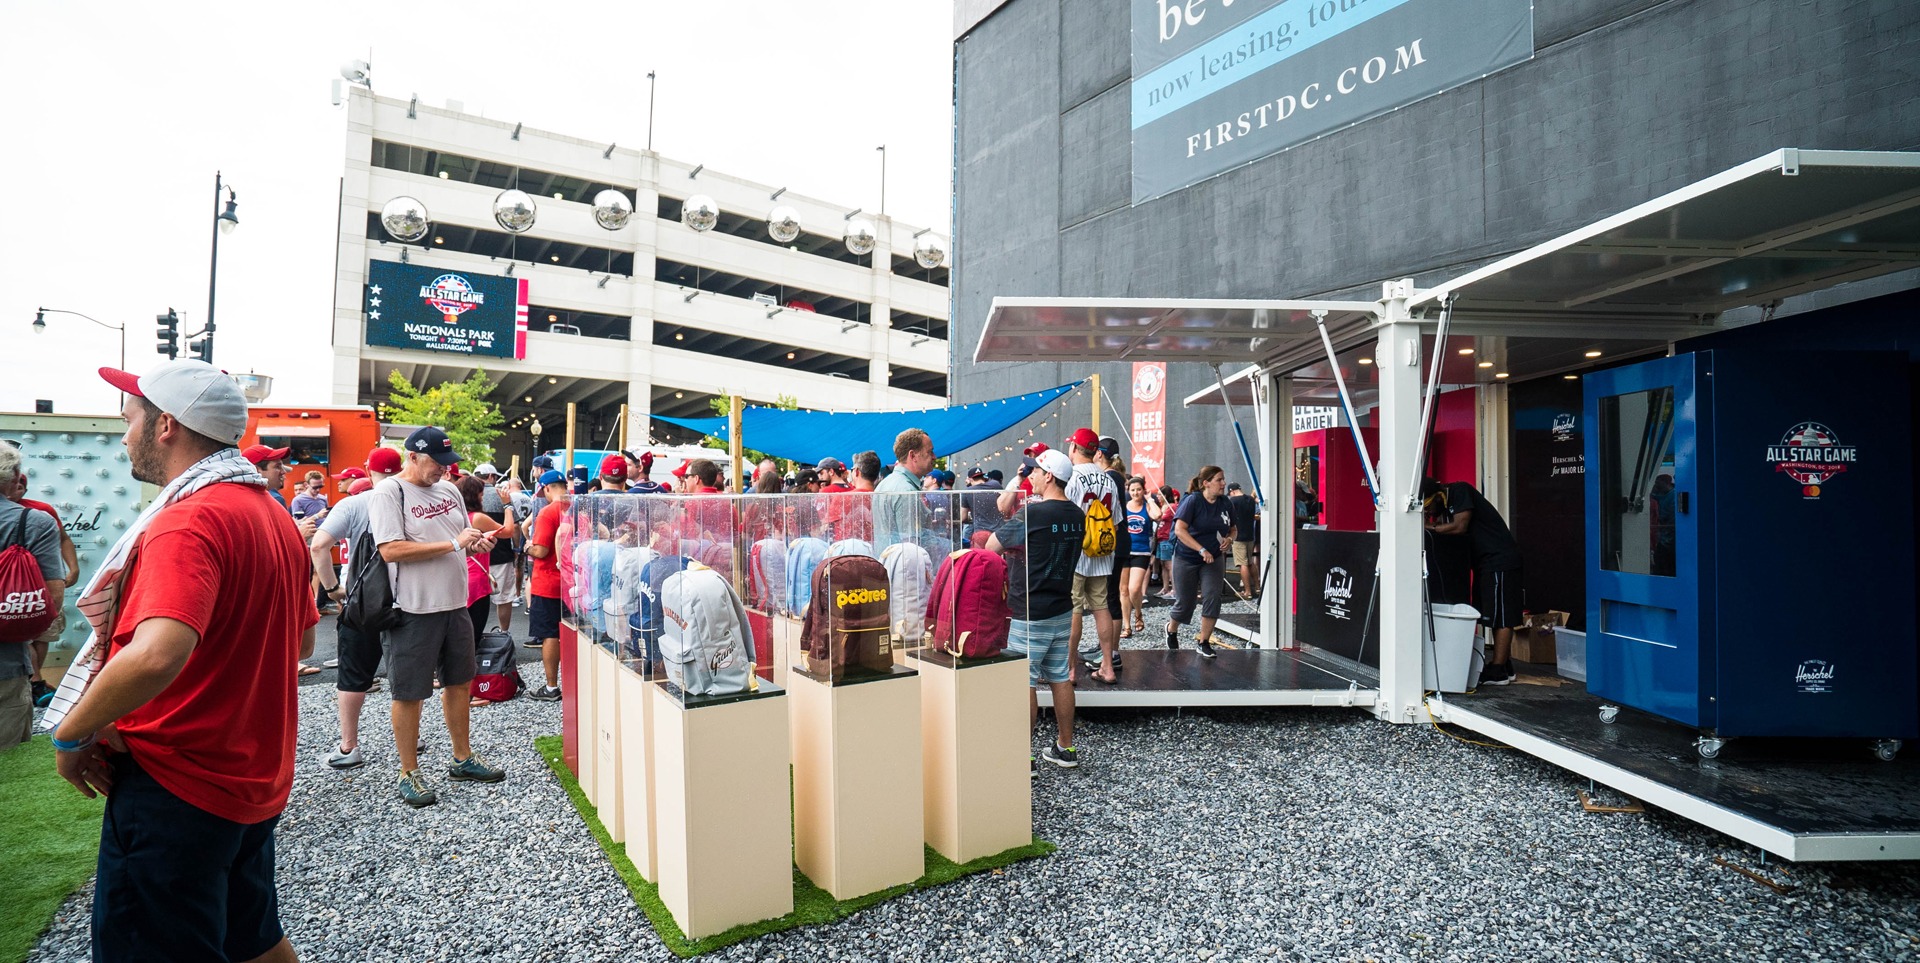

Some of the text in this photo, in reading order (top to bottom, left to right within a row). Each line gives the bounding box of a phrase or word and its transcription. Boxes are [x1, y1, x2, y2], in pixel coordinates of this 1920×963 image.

[1156, 0, 1207, 44] be
[1148, 0, 1368, 107] now leasing. tou
[419, 287, 436, 299] ALL
[437, 289, 460, 301] STAR
[460, 292, 484, 304] GAME
[404, 323, 495, 341] NATIONALS PARK
[409, 333, 438, 342] TONIGHT
[447, 337, 468, 345] 7:30PM
[426, 343, 473, 352] #ALLSTARGAME
[1134, 411, 1162, 430] BEER
[1295, 415, 1333, 431] GARDEN
[1134, 429, 1162, 443] GARDEN
[1766, 447, 1857, 462] ALL STAR GAME
[1360, 478, 1371, 487] AL
[63, 510, 101, 532] chel
[6, 587, 46, 604] CITY
[836, 588, 887, 610] padres
[0, 602, 46, 614] ORTS
[1795, 664, 1834, 683] Herschel
